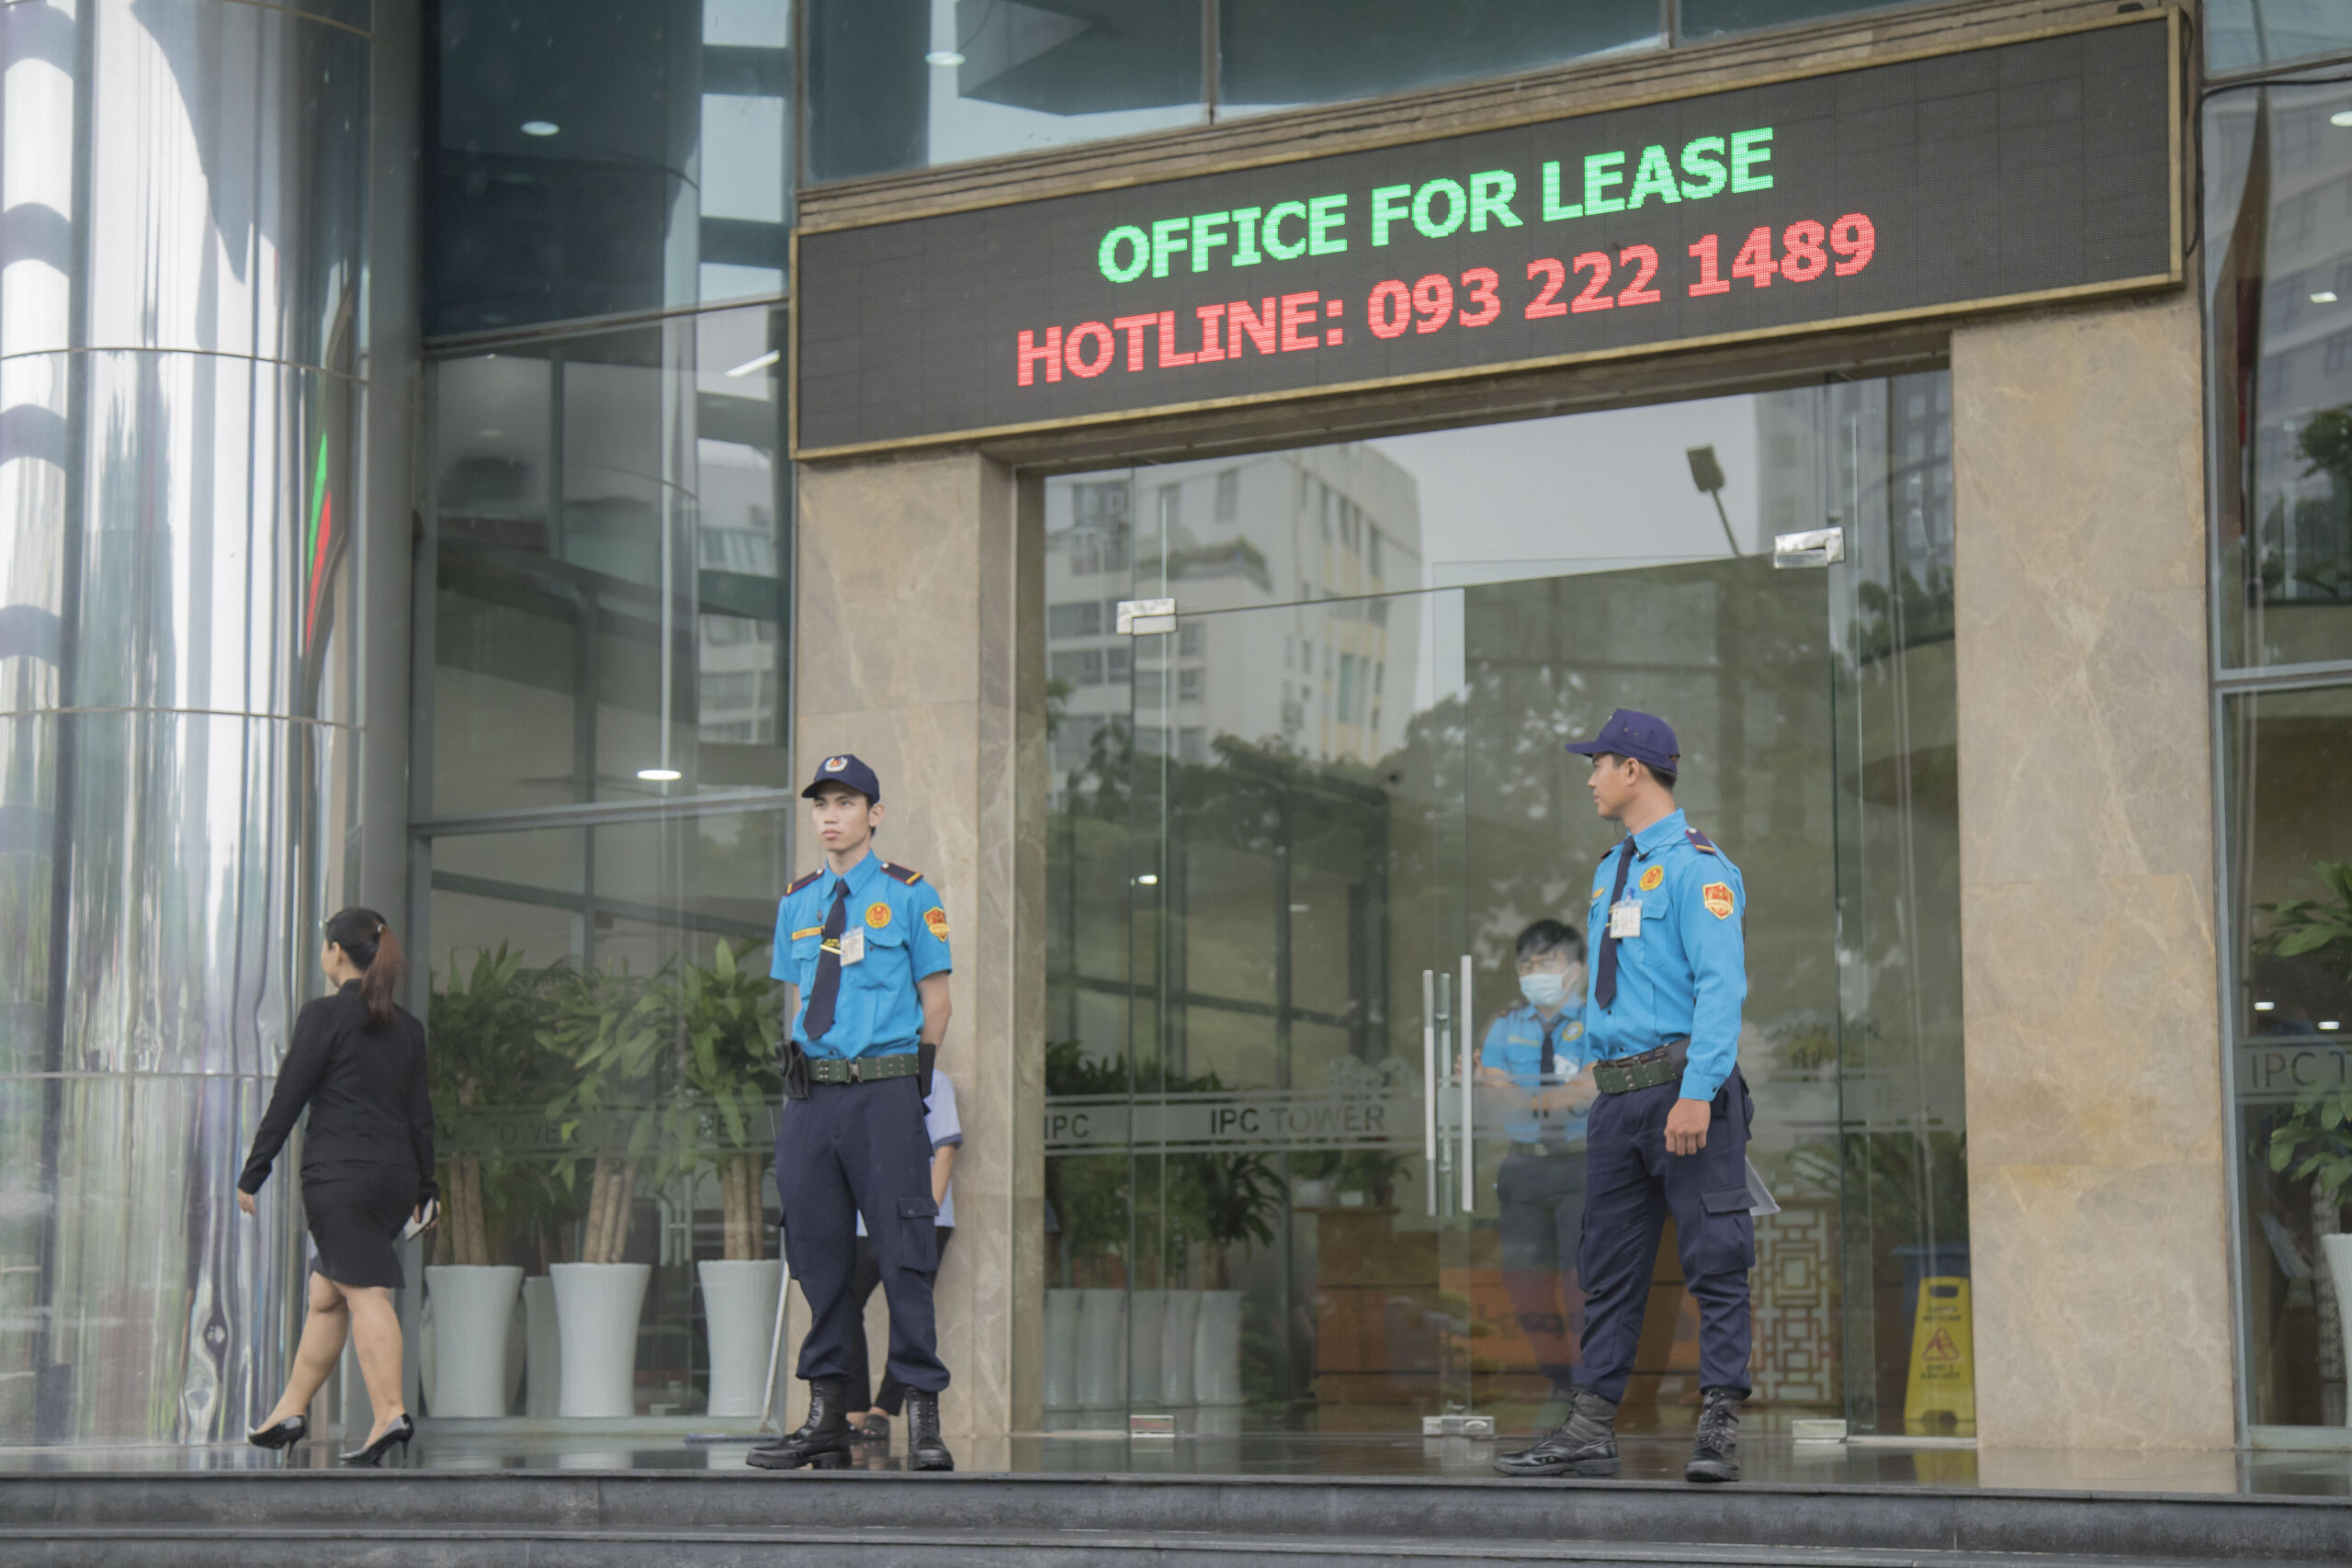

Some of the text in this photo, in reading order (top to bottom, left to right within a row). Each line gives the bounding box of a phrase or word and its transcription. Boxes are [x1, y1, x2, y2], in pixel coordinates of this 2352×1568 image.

[1098, 127, 1773, 284] OFFICE FOR LEASE
[1017, 212, 1875, 387] HOTLINE: 093 222 1489
[2251, 1051, 2317, 1088] IPC
[1045, 1114, 1090, 1140] IPC
[1211, 1105, 1385, 1134] IPC TOWER
